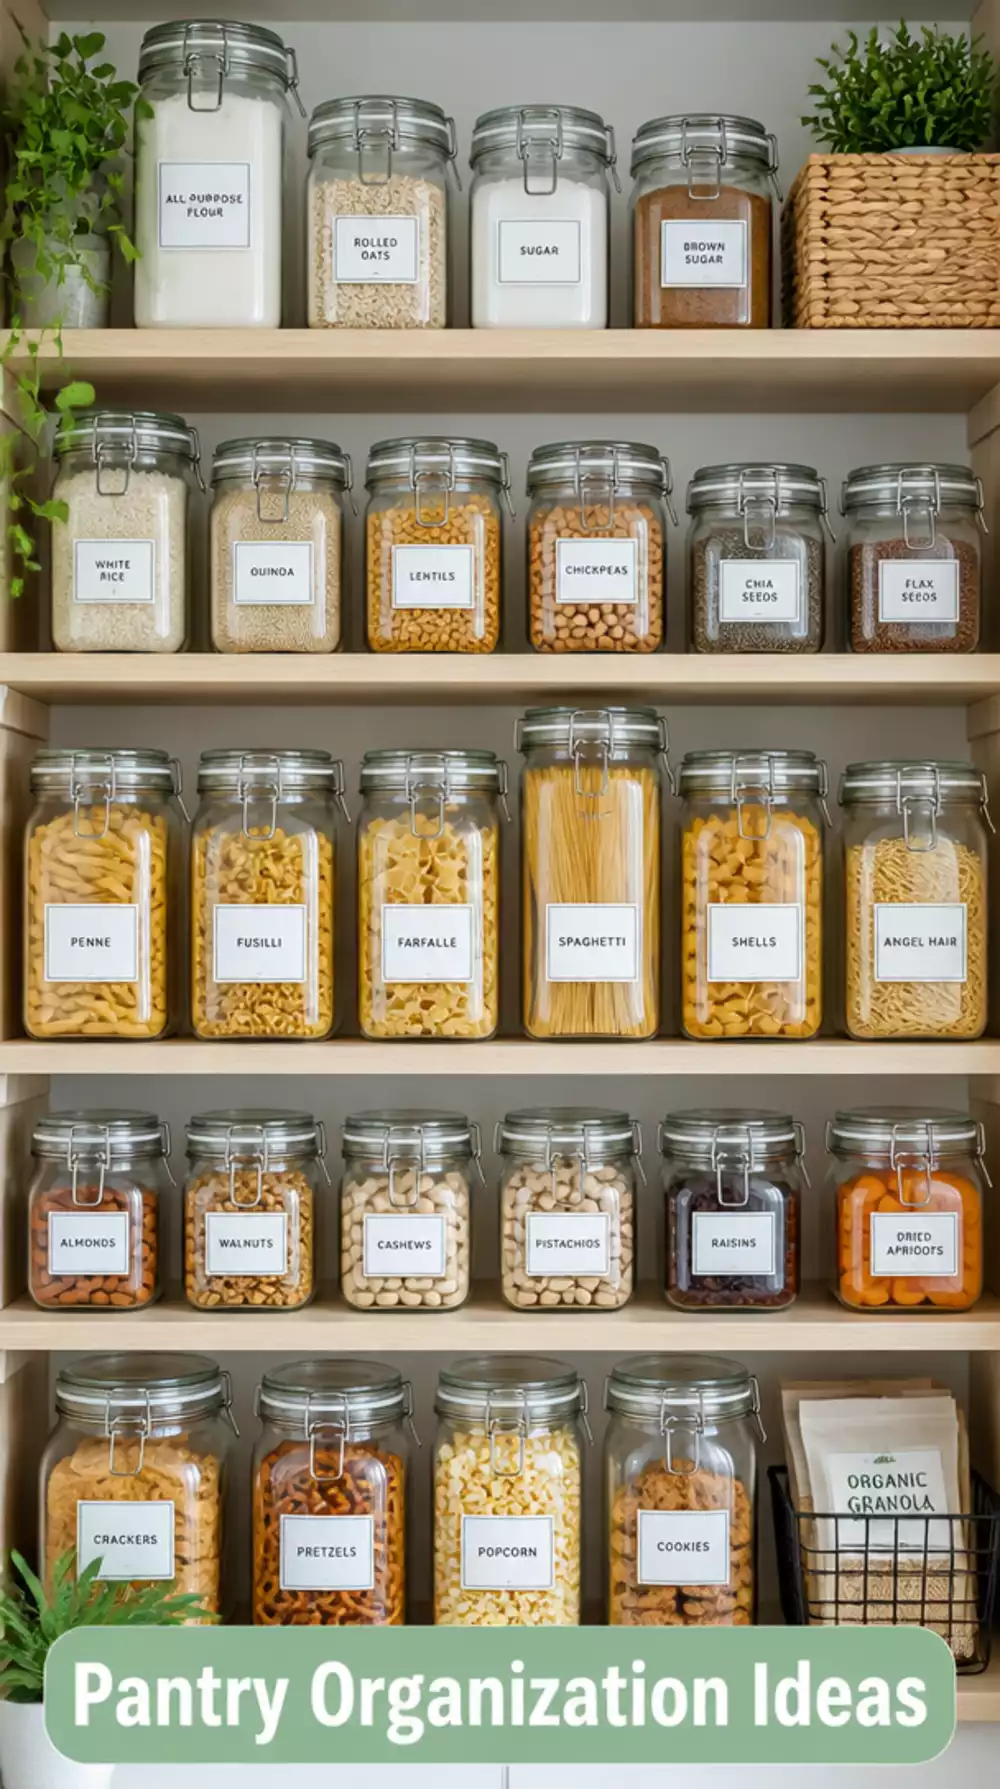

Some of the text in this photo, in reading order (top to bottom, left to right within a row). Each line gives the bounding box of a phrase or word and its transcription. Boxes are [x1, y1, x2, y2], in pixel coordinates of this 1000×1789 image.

[165, 193, 187, 205] ALL
[353, 237, 399, 248] ROLLED
[683, 241, 726, 252] BROWN
[360, 250, 392, 261] OATS
[519, 245, 560, 256] SUGAR
[684, 254, 724, 265] SUGAR
[94, 559, 132, 570] WHITE
[563, 564, 629, 576] CHICKPEAS
[99, 571, 126, 582] RICE
[409, 571, 456, 582] LENTILS
[743, 578, 775, 590] CHIA
[904, 578, 935, 589] FLAX
[741, 591, 780, 603] SEEDS
[70, 936, 112, 948] PENNE
[236, 936, 282, 949] FUSILLI
[396, 936, 458, 949] FARFALLE
[558, 936, 627, 948] SPAGHETTI
[731, 936, 777, 948] SHELLS
[883, 936, 959, 948] ANGEL HAIR
[59, 1237, 117, 1249] ALMONDS
[218, 1238, 275, 1249] WALNUTS
[375, 1239, 433, 1251] CASHEWS
[535, 1238, 602, 1250] PISTACHIOS
[710, 1237, 758, 1249] RAISINS
[846, 1471, 929, 1490] ORGANIC
[846, 1493, 937, 1515] GRANOLA
[92, 1534, 158, 1546] CRACKERS
[296, 1546, 358, 1558] PRETZELS
[476, 1546, 538, 1558] POPCORN
[656, 1541, 710, 1553] COOKIES
